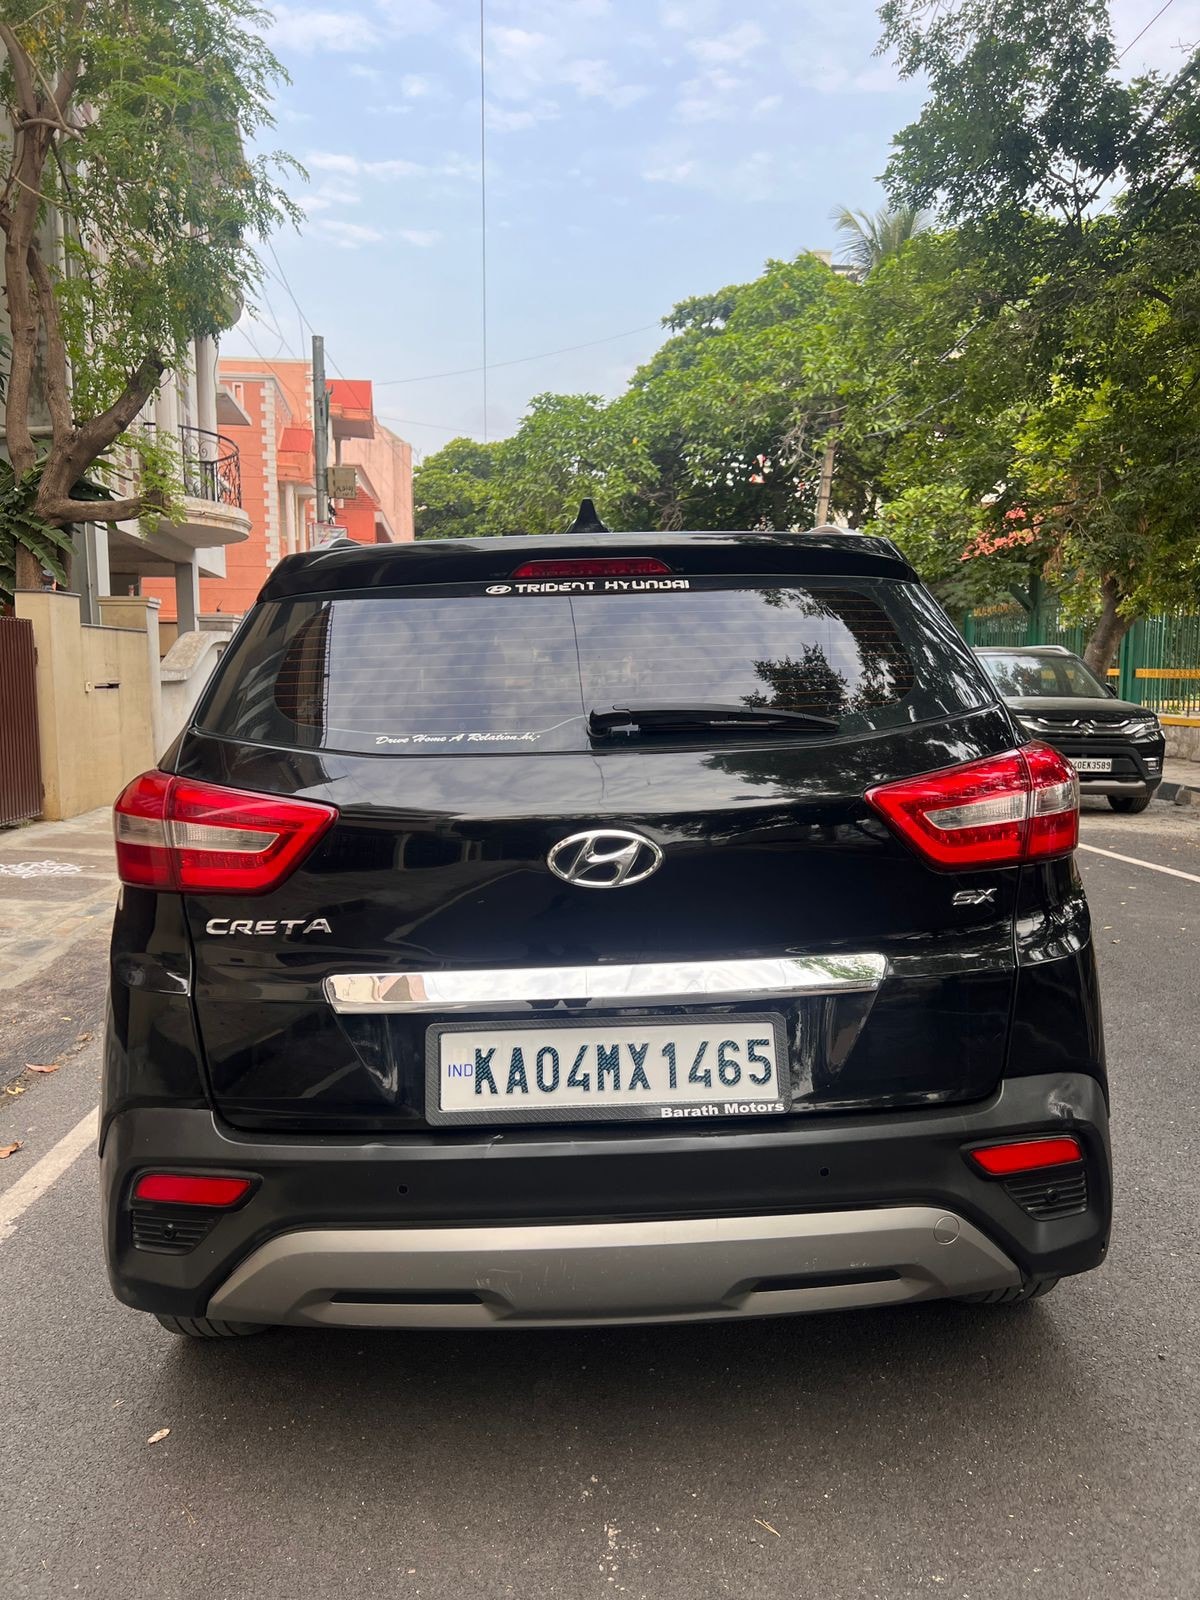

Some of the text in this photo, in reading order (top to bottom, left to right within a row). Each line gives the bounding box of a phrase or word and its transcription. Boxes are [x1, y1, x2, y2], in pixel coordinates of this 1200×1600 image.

[515, 579, 690, 593] TRIDENT HYUNDAI
[412, 733, 447, 743] Home
[449, 732, 466, 742] A
[952, 887, 998, 905] SX
[205, 918, 332, 935] CRETA
[447, 1038, 773, 1096] IND KA04MX1465
[660, 1102, 785, 1118] Barath Motors
